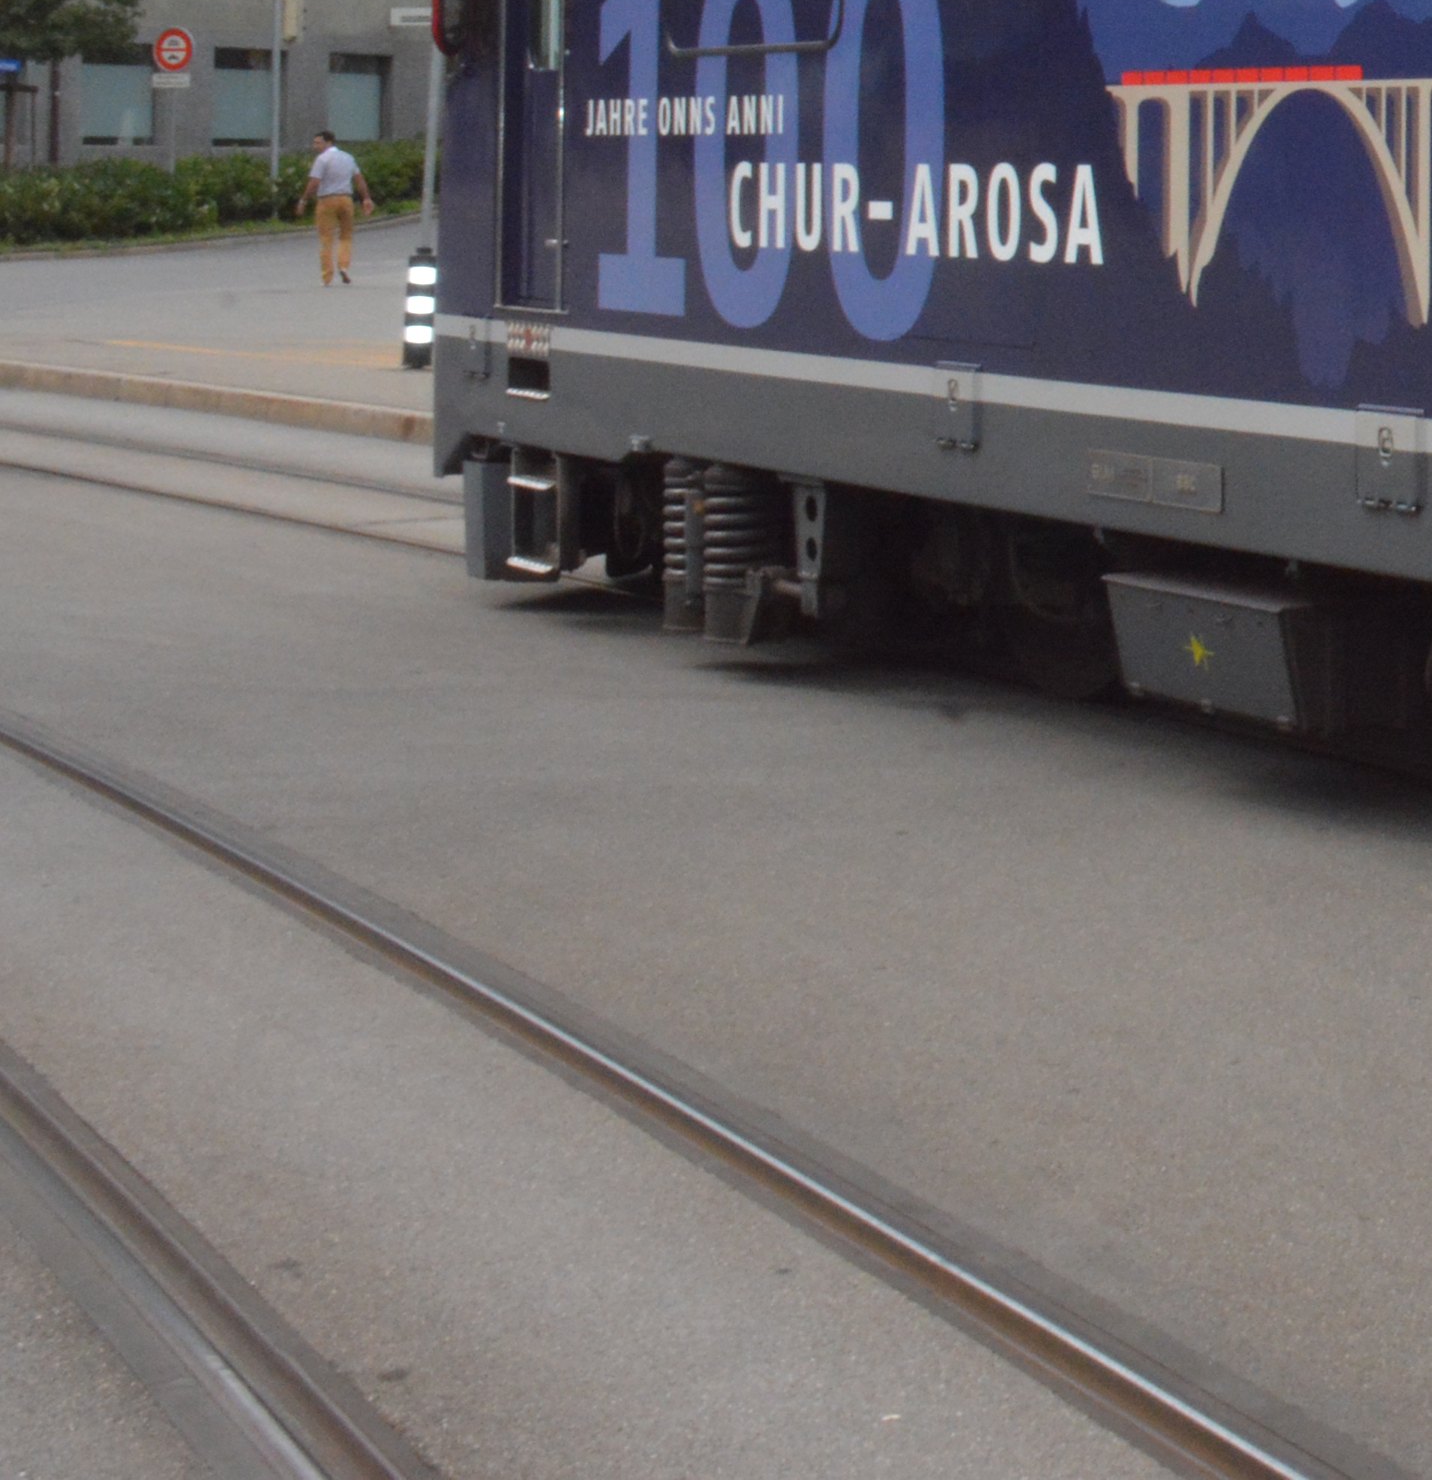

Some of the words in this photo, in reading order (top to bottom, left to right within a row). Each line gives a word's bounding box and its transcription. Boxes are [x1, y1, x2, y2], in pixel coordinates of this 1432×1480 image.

[585, 98, 648, 136] JAHRE
[657, 96, 716, 135] ONNS
[726, 94, 785, 134] ANNI
[728, 161, 1104, 266] CHUR-AROSA
